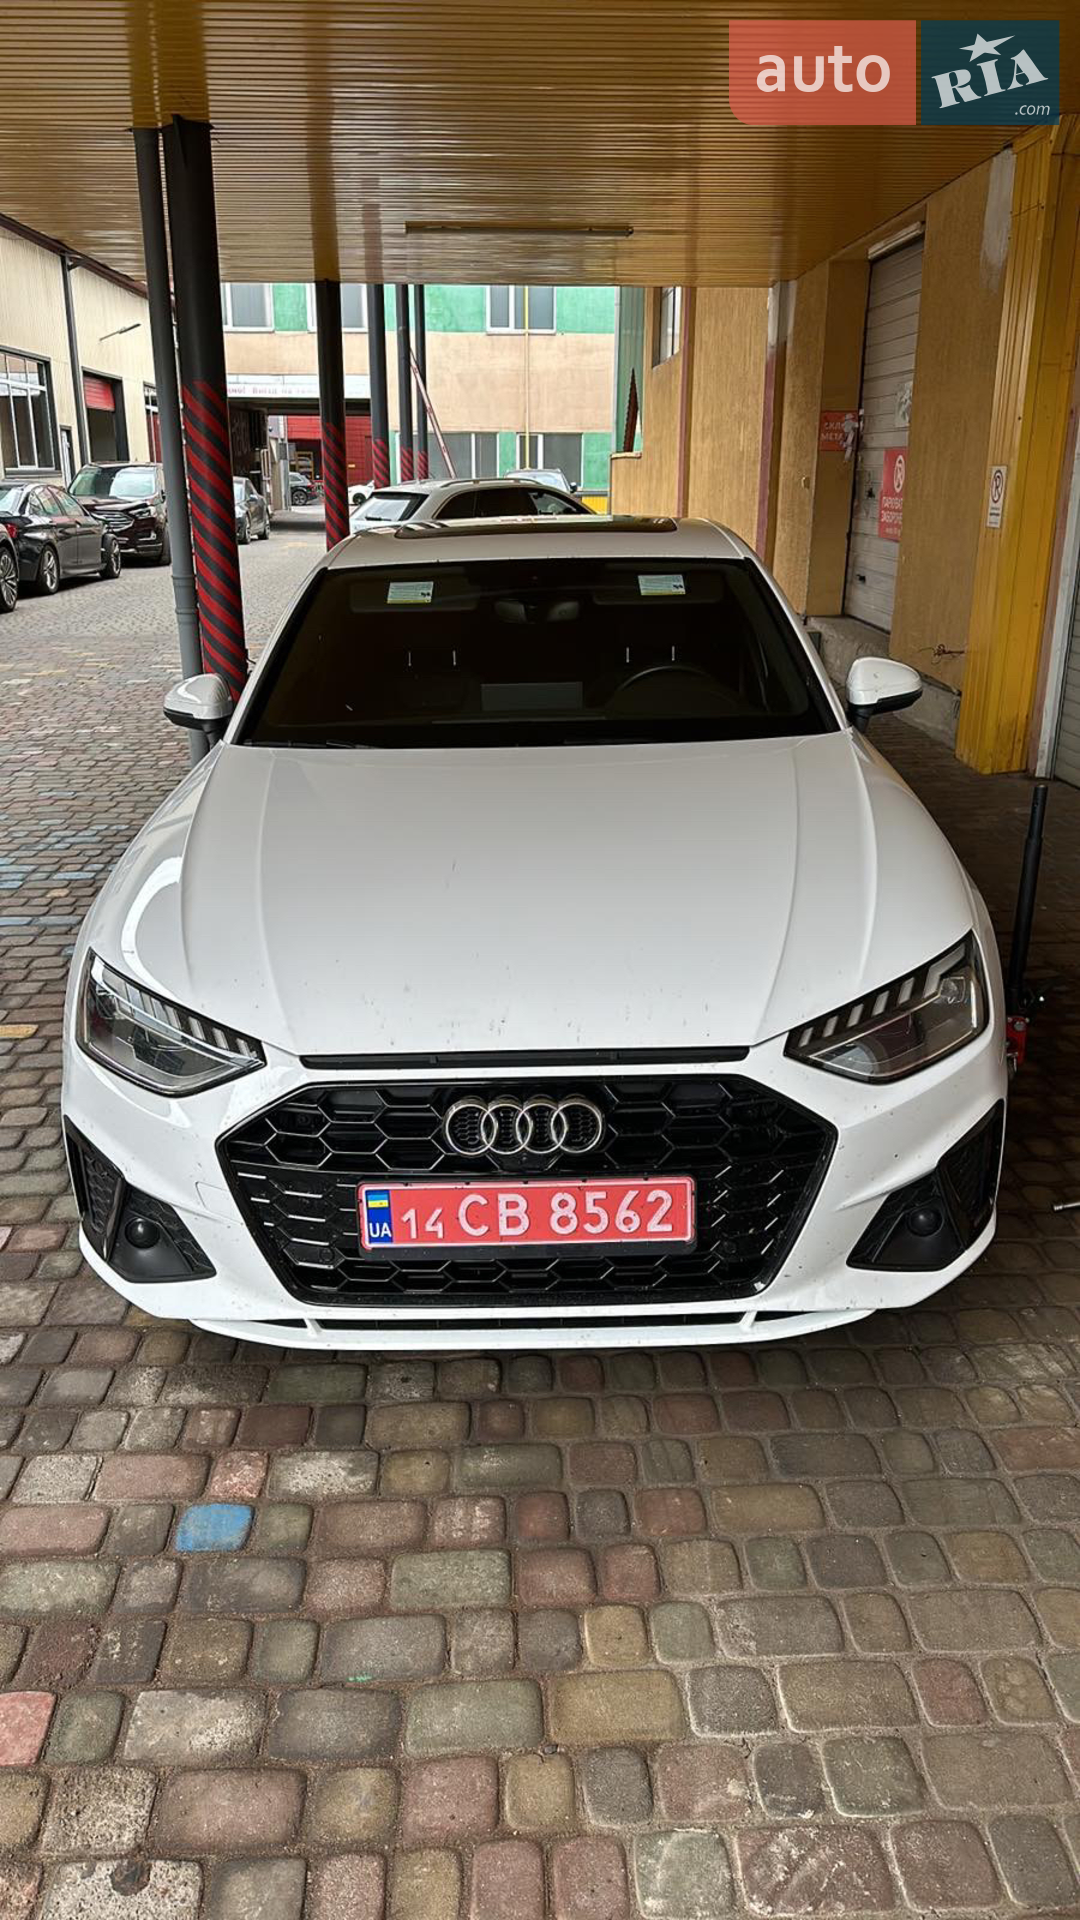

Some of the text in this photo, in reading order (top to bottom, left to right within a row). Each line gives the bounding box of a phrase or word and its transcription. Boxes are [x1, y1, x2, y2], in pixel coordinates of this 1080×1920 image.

[368, 1222, 392, 1239] UA
[400, 1189, 673, 1239] 14 CB 8562
